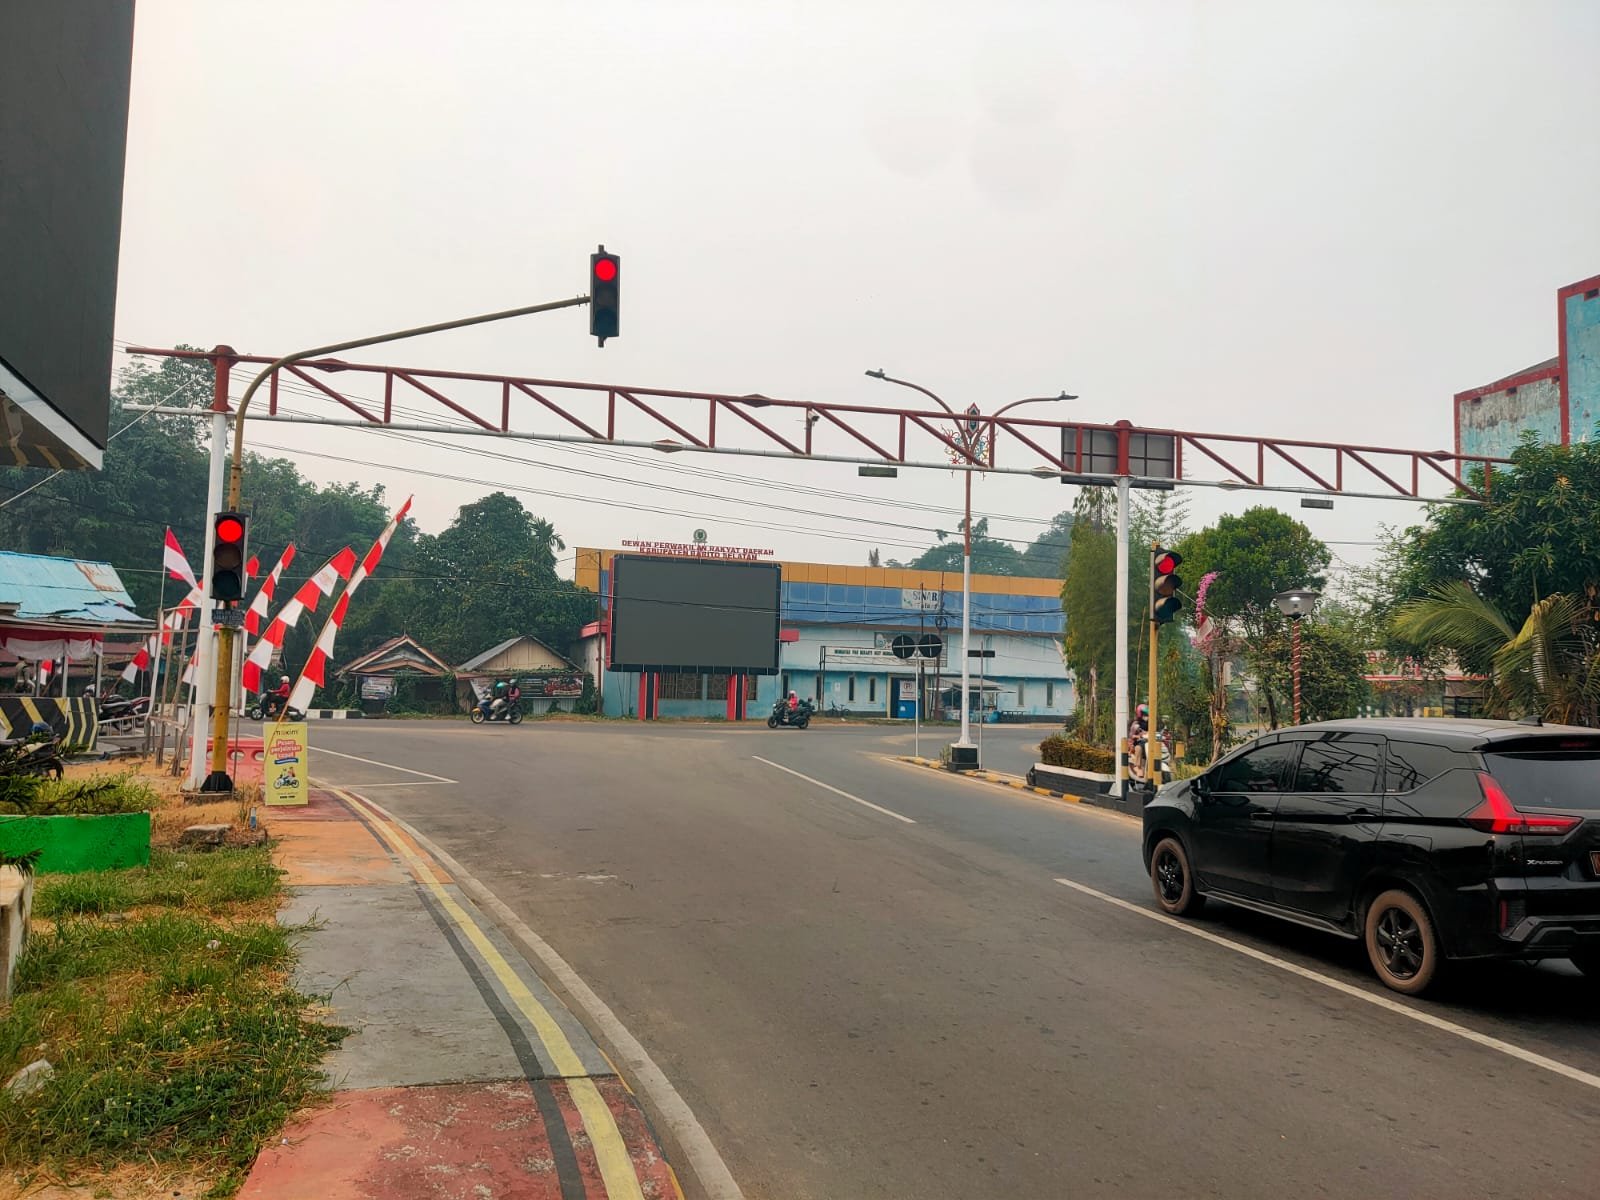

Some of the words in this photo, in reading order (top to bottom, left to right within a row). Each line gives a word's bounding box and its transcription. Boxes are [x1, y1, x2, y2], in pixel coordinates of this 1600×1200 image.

[654, 542, 707, 551] PERWAKILAN
[709, 546, 741, 554] RAKYAT
[743, 548, 774, 556] DAERAH
